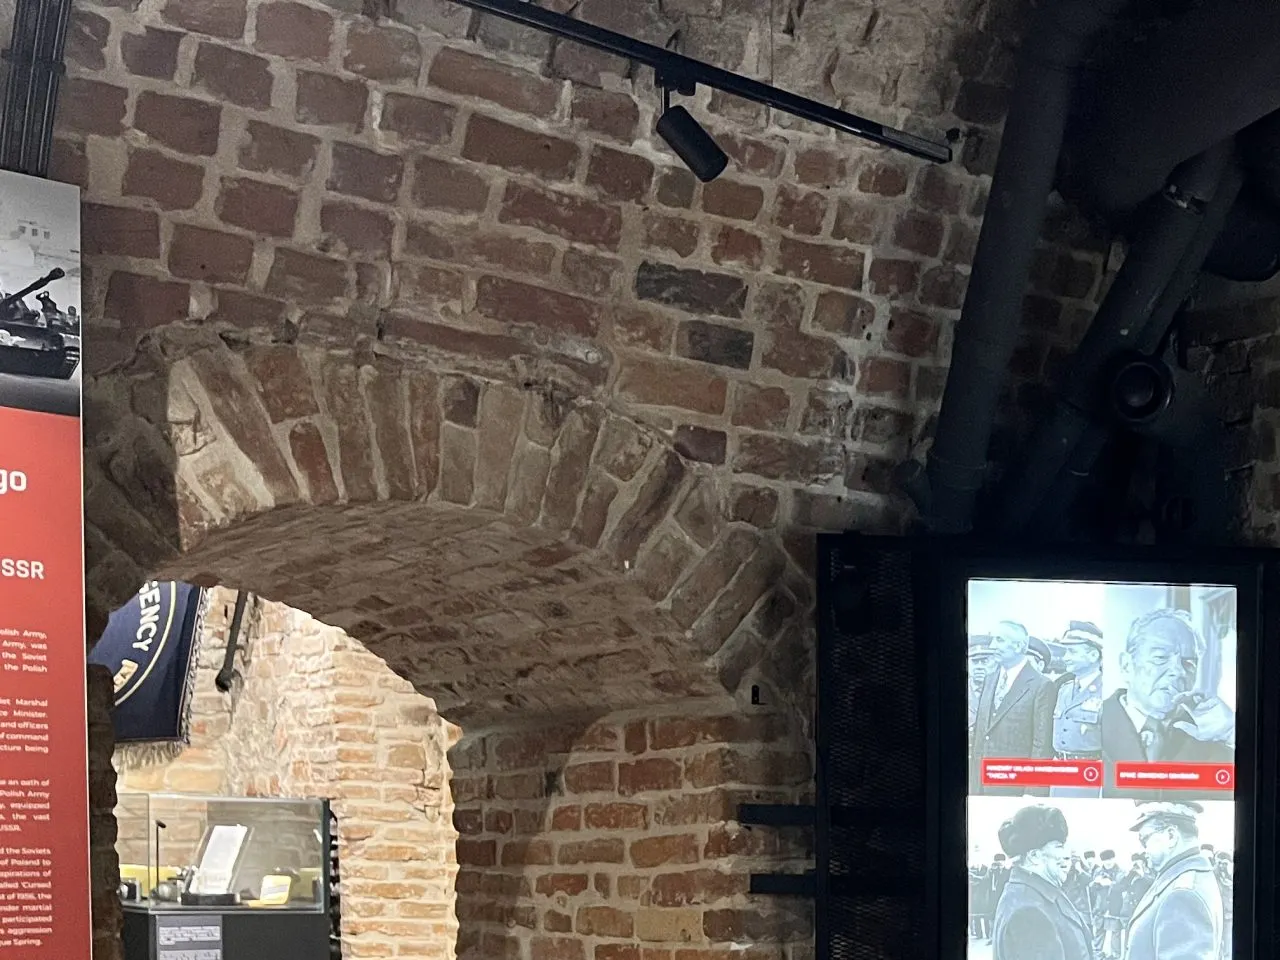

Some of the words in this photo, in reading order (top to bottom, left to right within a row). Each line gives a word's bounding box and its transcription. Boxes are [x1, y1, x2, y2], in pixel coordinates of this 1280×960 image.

[22, 653, 46, 662] Soviet
[22, 664, 48, 672] Polish
[15, 698, 48, 706] Marshal
[17, 721, 48, 730] officers
[24, 745, 48, 754] being
[27, 790, 50, 800] Army
[11, 812, 26, 820] the
[21, 847, 50, 855] Soviets
[42, 869, 52, 878] of
[2, 915, 52, 924] participated
[7, 927, 52, 936] aggression
